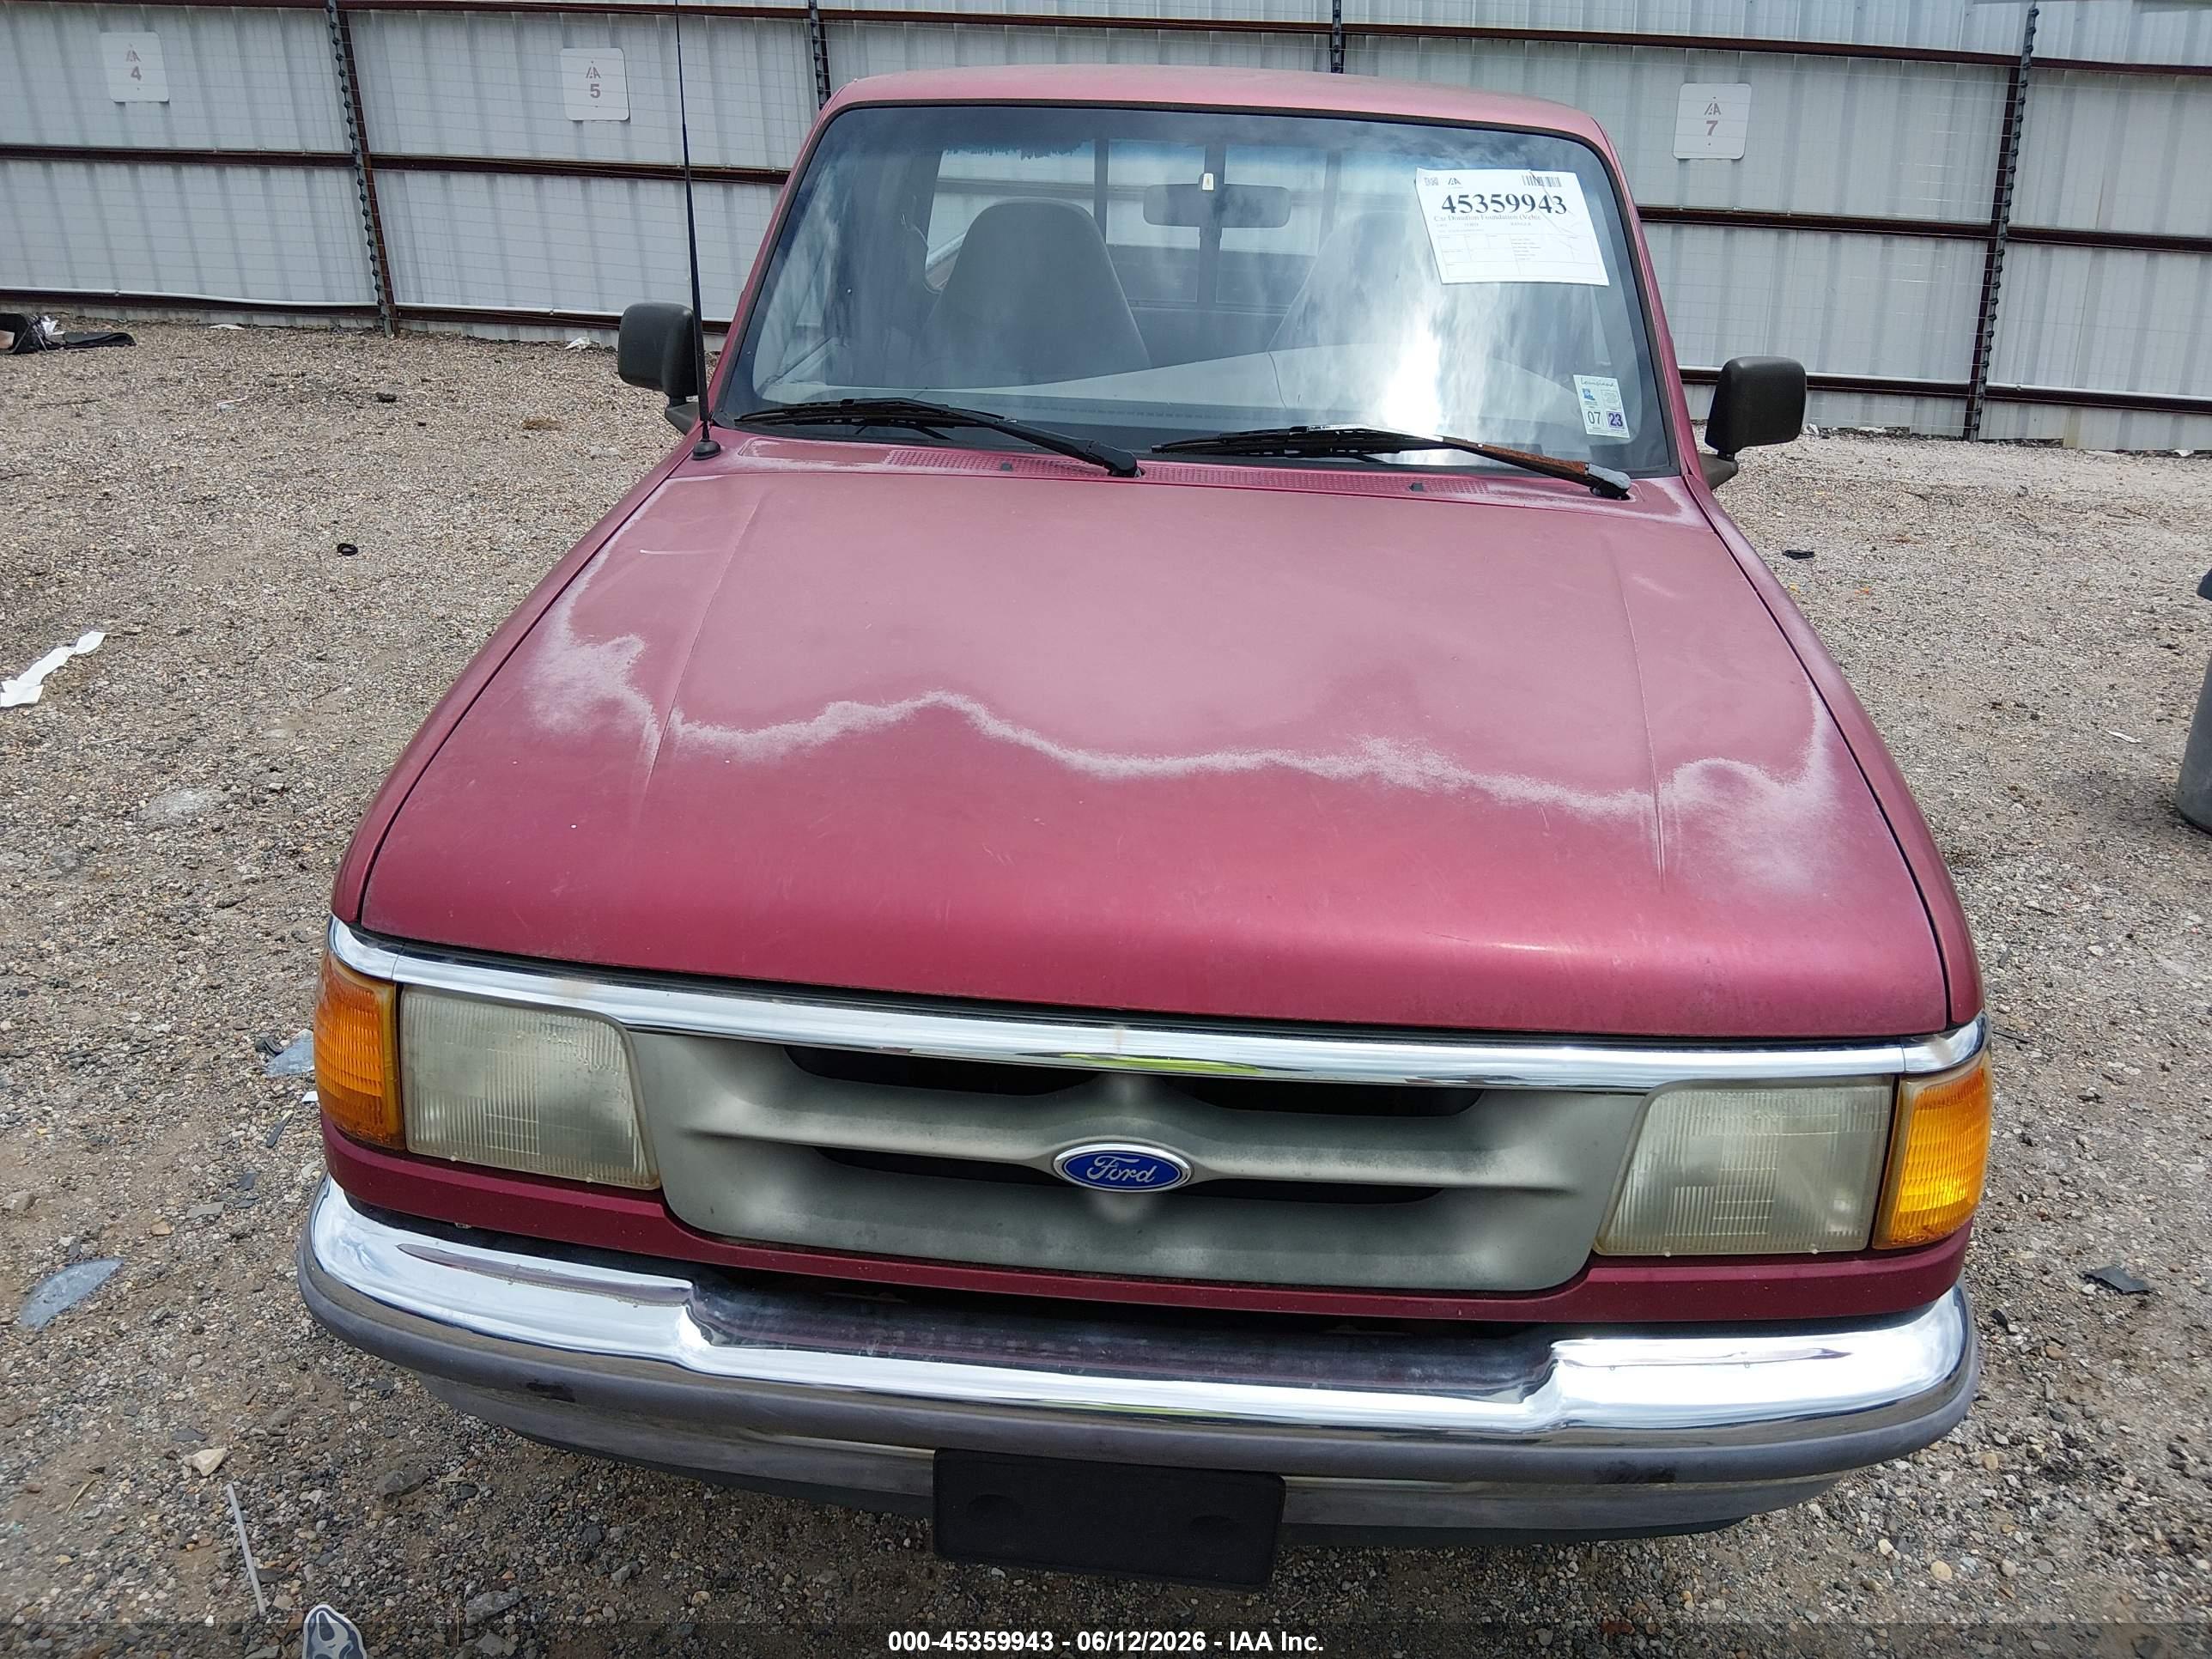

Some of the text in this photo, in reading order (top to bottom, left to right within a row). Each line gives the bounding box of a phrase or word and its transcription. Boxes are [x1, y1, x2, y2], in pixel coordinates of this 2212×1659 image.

[131, 66, 142, 81] 4
[590, 83, 601, 98] 5
[1706, 120, 1718, 137] 7
[1441, 193, 1567, 215] 45359943
[1587, 410, 1623, 427] 07 23
[1086, 1155, 1158, 1183] Ford
